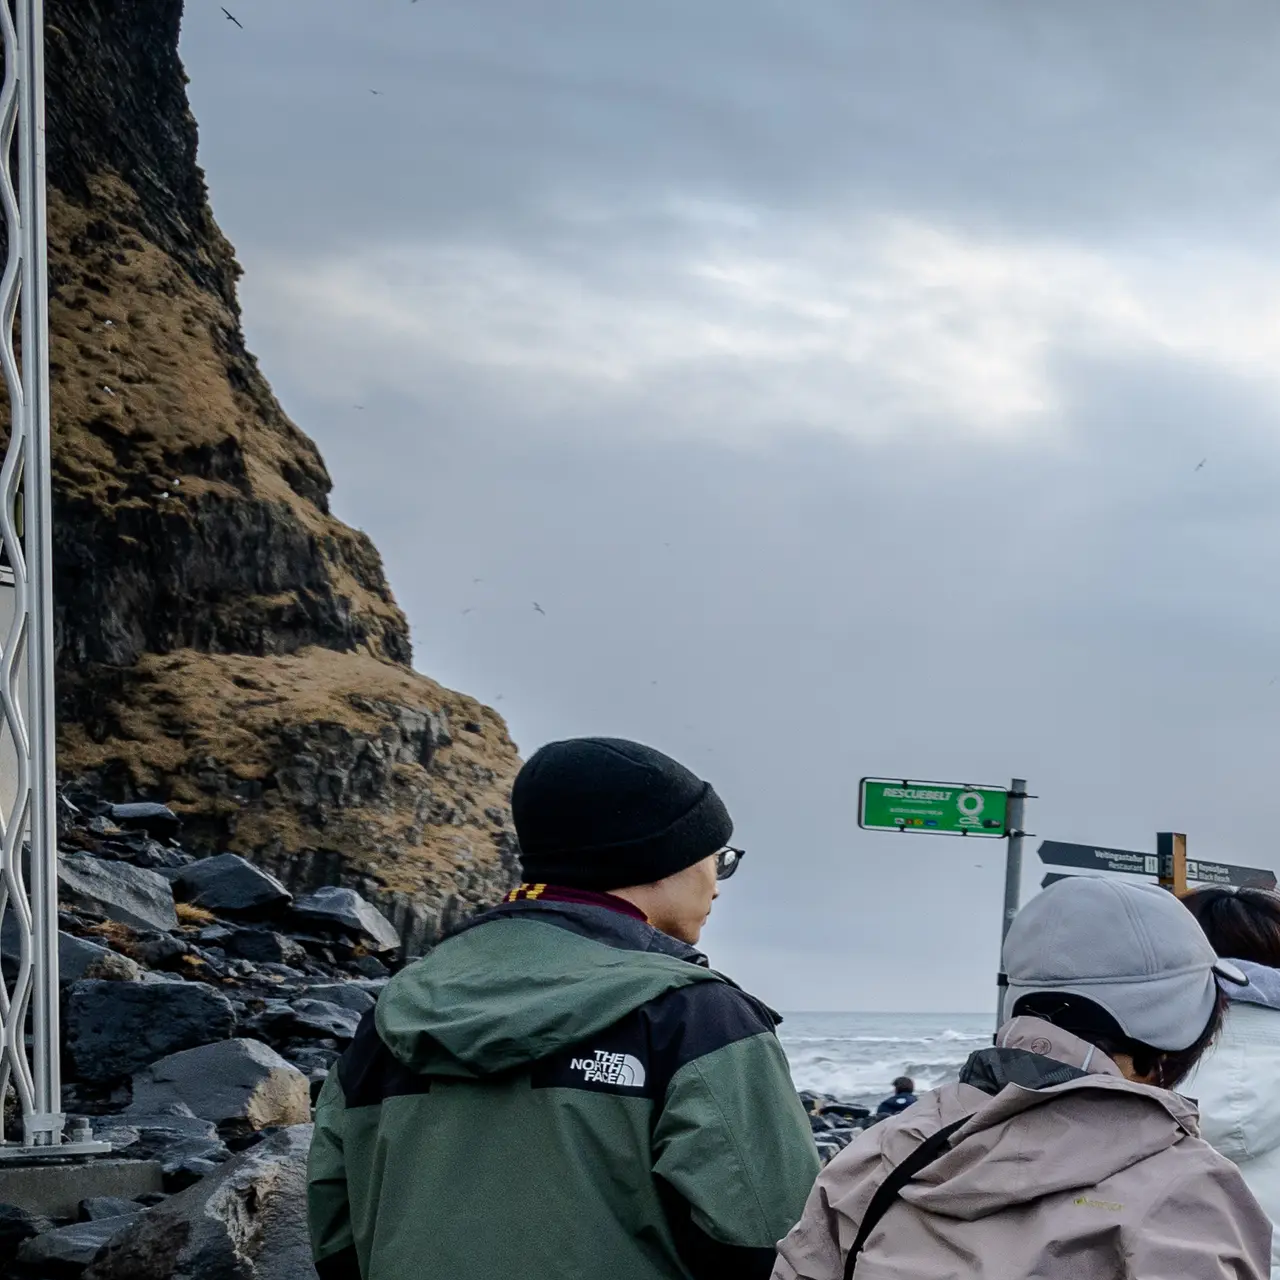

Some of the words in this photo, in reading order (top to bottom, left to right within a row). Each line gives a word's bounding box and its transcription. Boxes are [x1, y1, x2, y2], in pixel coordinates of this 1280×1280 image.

[594, 1050, 625, 1064] THE
[570, 1058, 622, 1074] NORTH
[584, 1070, 618, 1084] FACE
